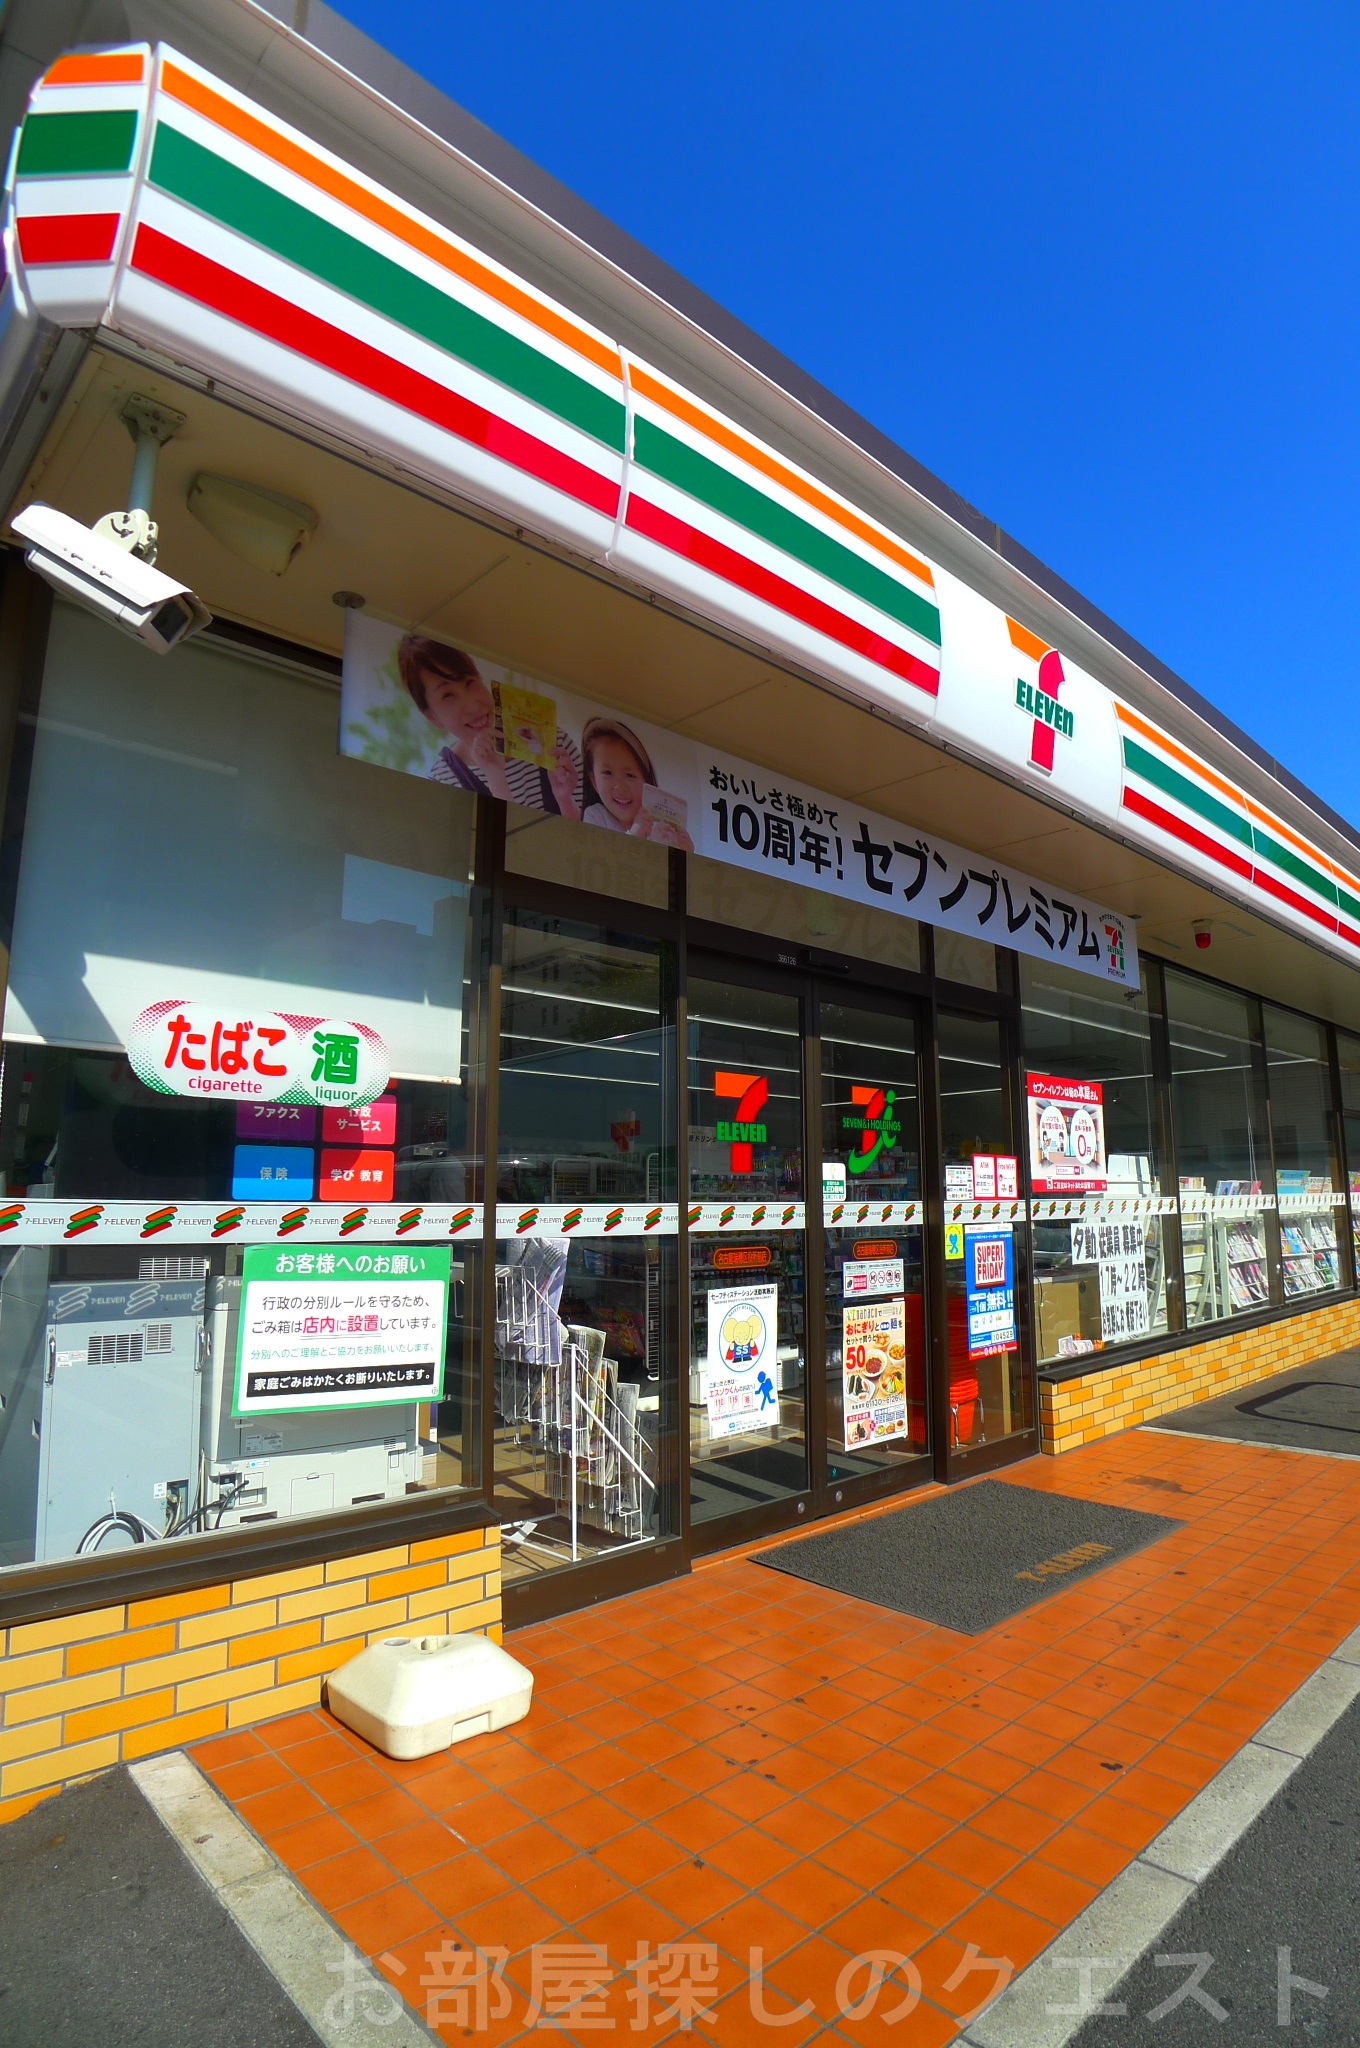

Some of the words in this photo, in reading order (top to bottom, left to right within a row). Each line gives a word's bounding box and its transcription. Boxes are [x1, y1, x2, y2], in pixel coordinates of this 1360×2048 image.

[709, 766, 839, 832] おいしさ極めて
[852, 821, 1100, 961] セブンプレミアム
[164, 1014, 287, 1076] たばこ
[311, 1031, 359, 1085] 酒
[188, 1076, 263, 1094] cigarette
[315, 1086, 358, 1102] liquor
[253, 1106, 300, 1120] ファクス
[336, 1119, 382, 1131] サービス
[330, 1169, 354, 1181] 学び
[359, 1169, 384, 1183] 教育
[1073, 1225, 1097, 1260] 夕勤
[275, 1253, 426, 1275] お客様へのお願い
[977, 1262, 1004, 1281] FRIDAY
[262, 1295, 430, 1311] 行政の分別ルールを守るため、
[252, 1315, 437, 1335] ごみ箱は店内に設置しています。
[250, 1343, 434, 1361] 分別へのご理解とご協力をお願いいたします。
[735, 1345, 749, 1356] SS
[845, 1344, 866, 1370] 50
[253, 1368, 430, 1392] 家庭ごみはかたくお断りいたします。
